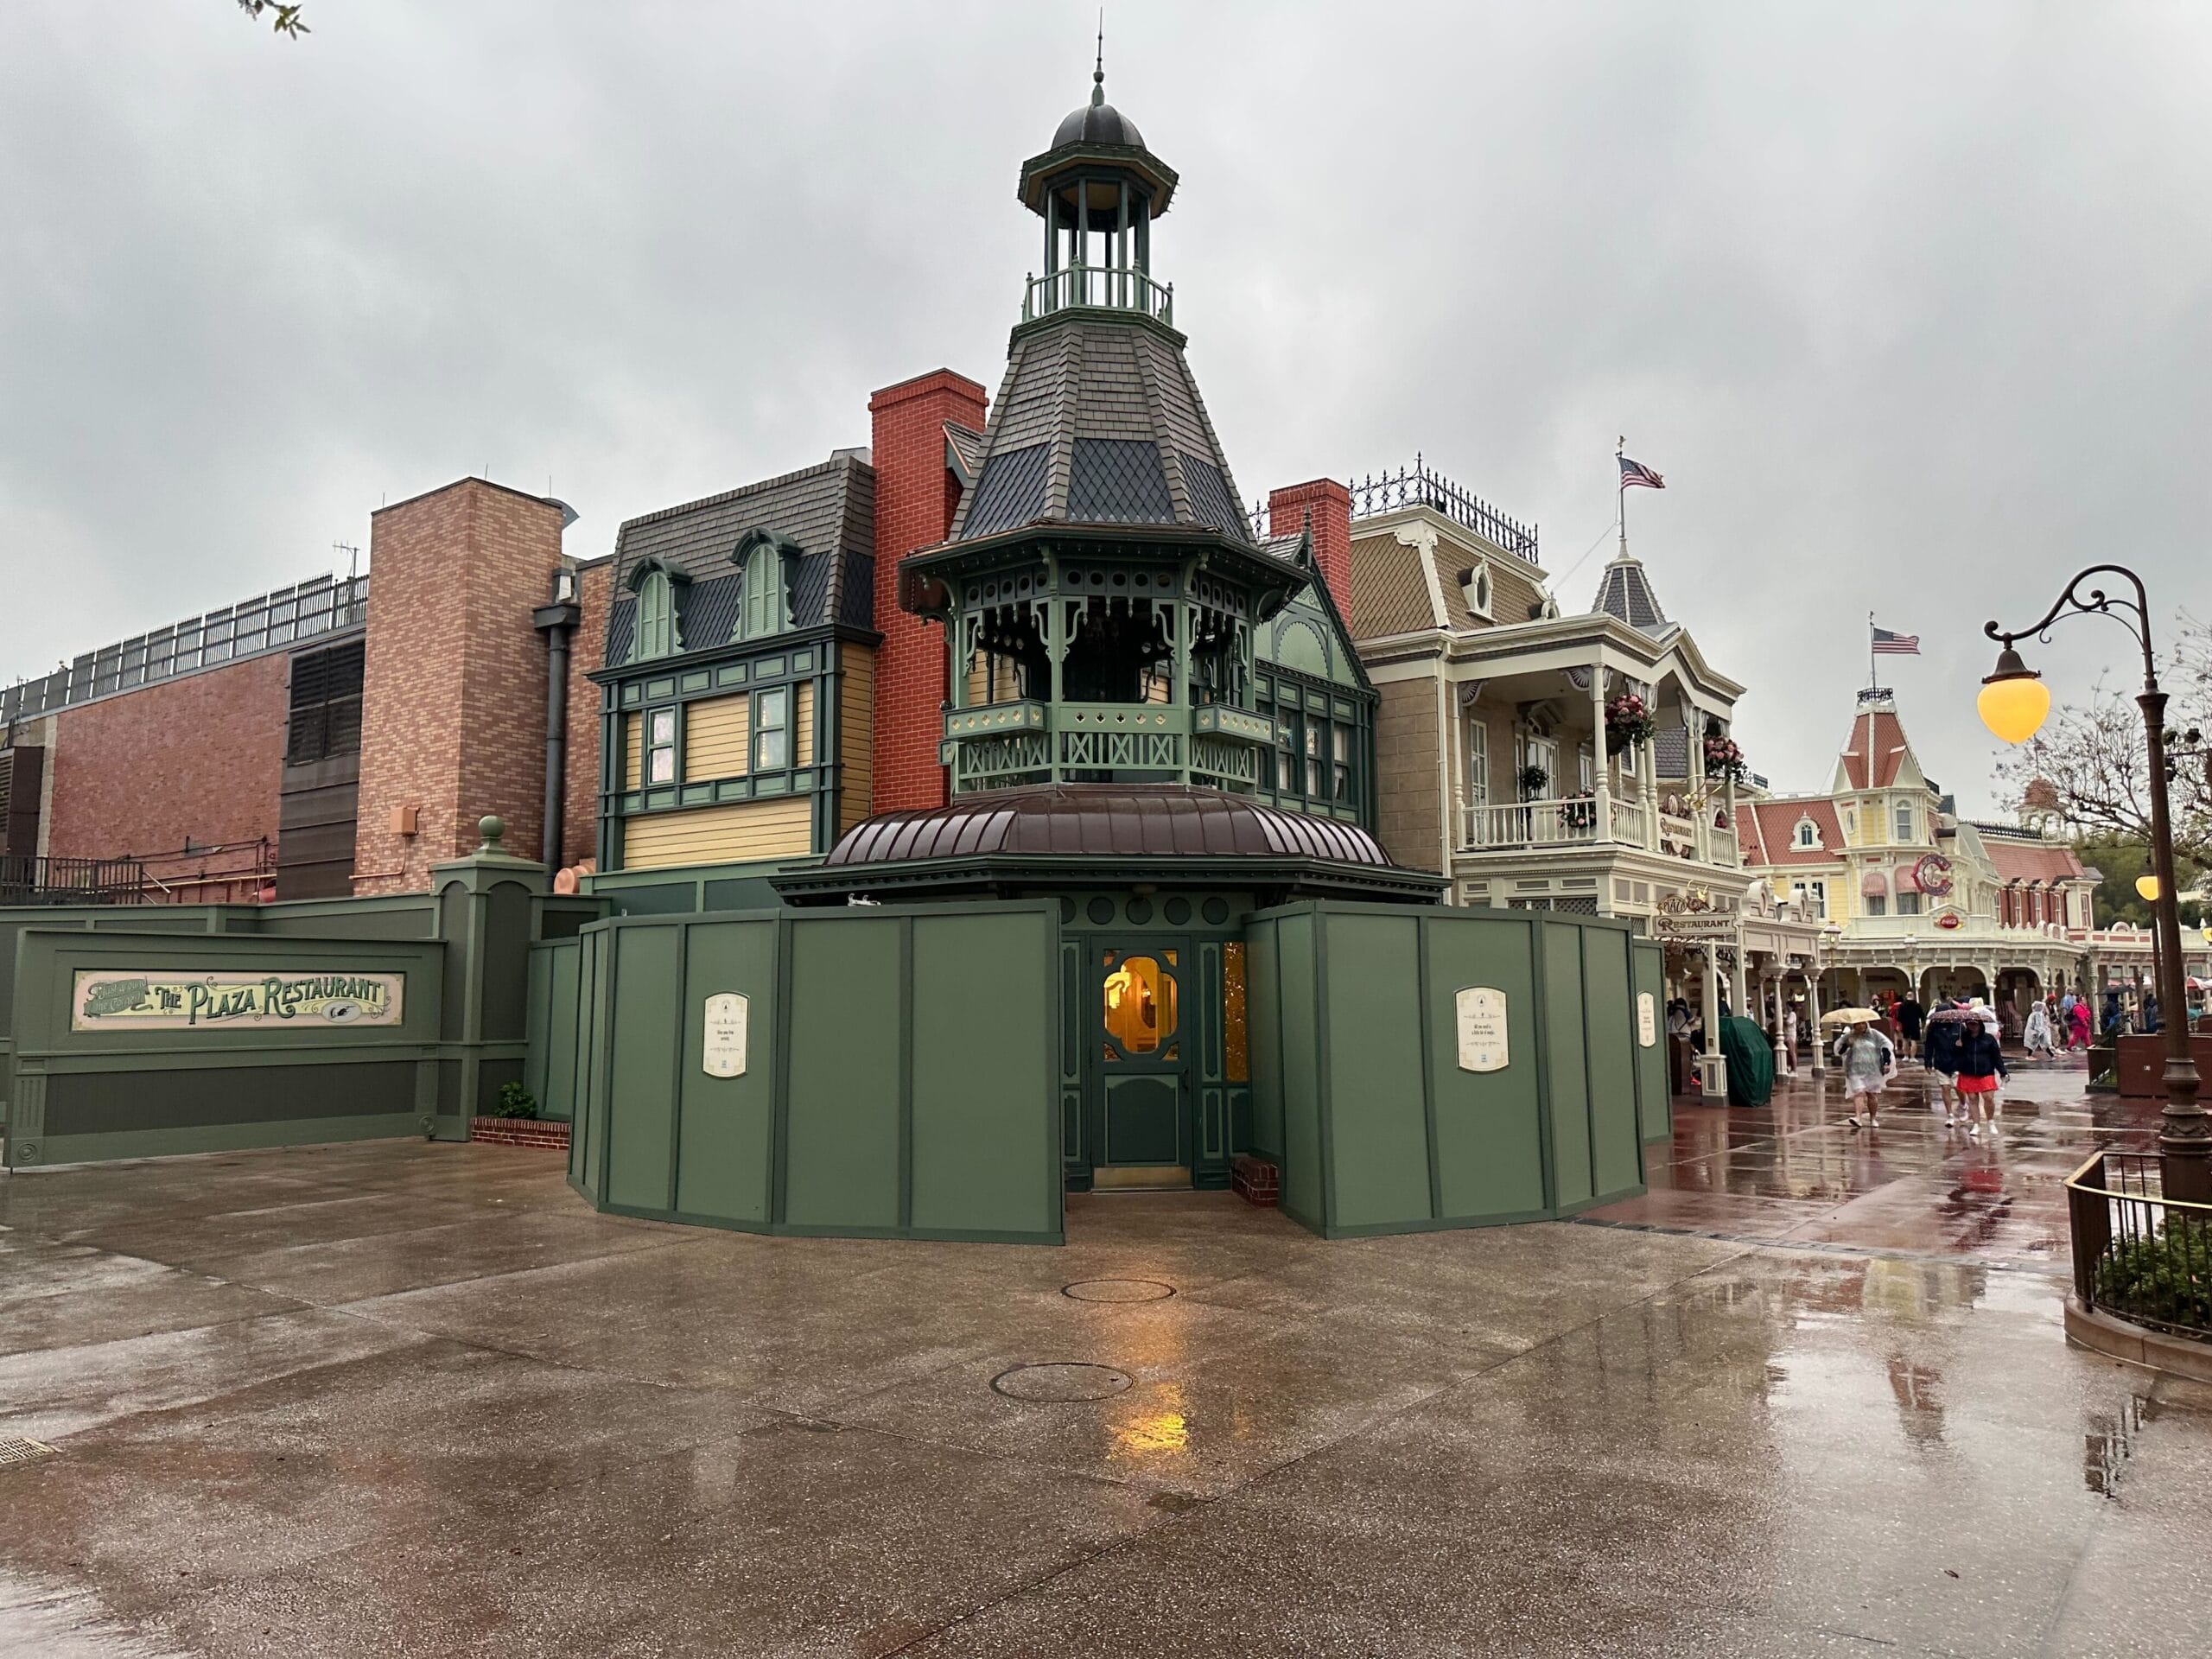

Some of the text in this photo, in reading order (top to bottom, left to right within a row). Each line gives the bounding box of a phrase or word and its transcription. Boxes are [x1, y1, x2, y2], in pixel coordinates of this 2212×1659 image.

[1657, 918, 1730, 933] RESTAURANT
[155, 976, 381, 1026] THE PLAZA RESTAURANT
